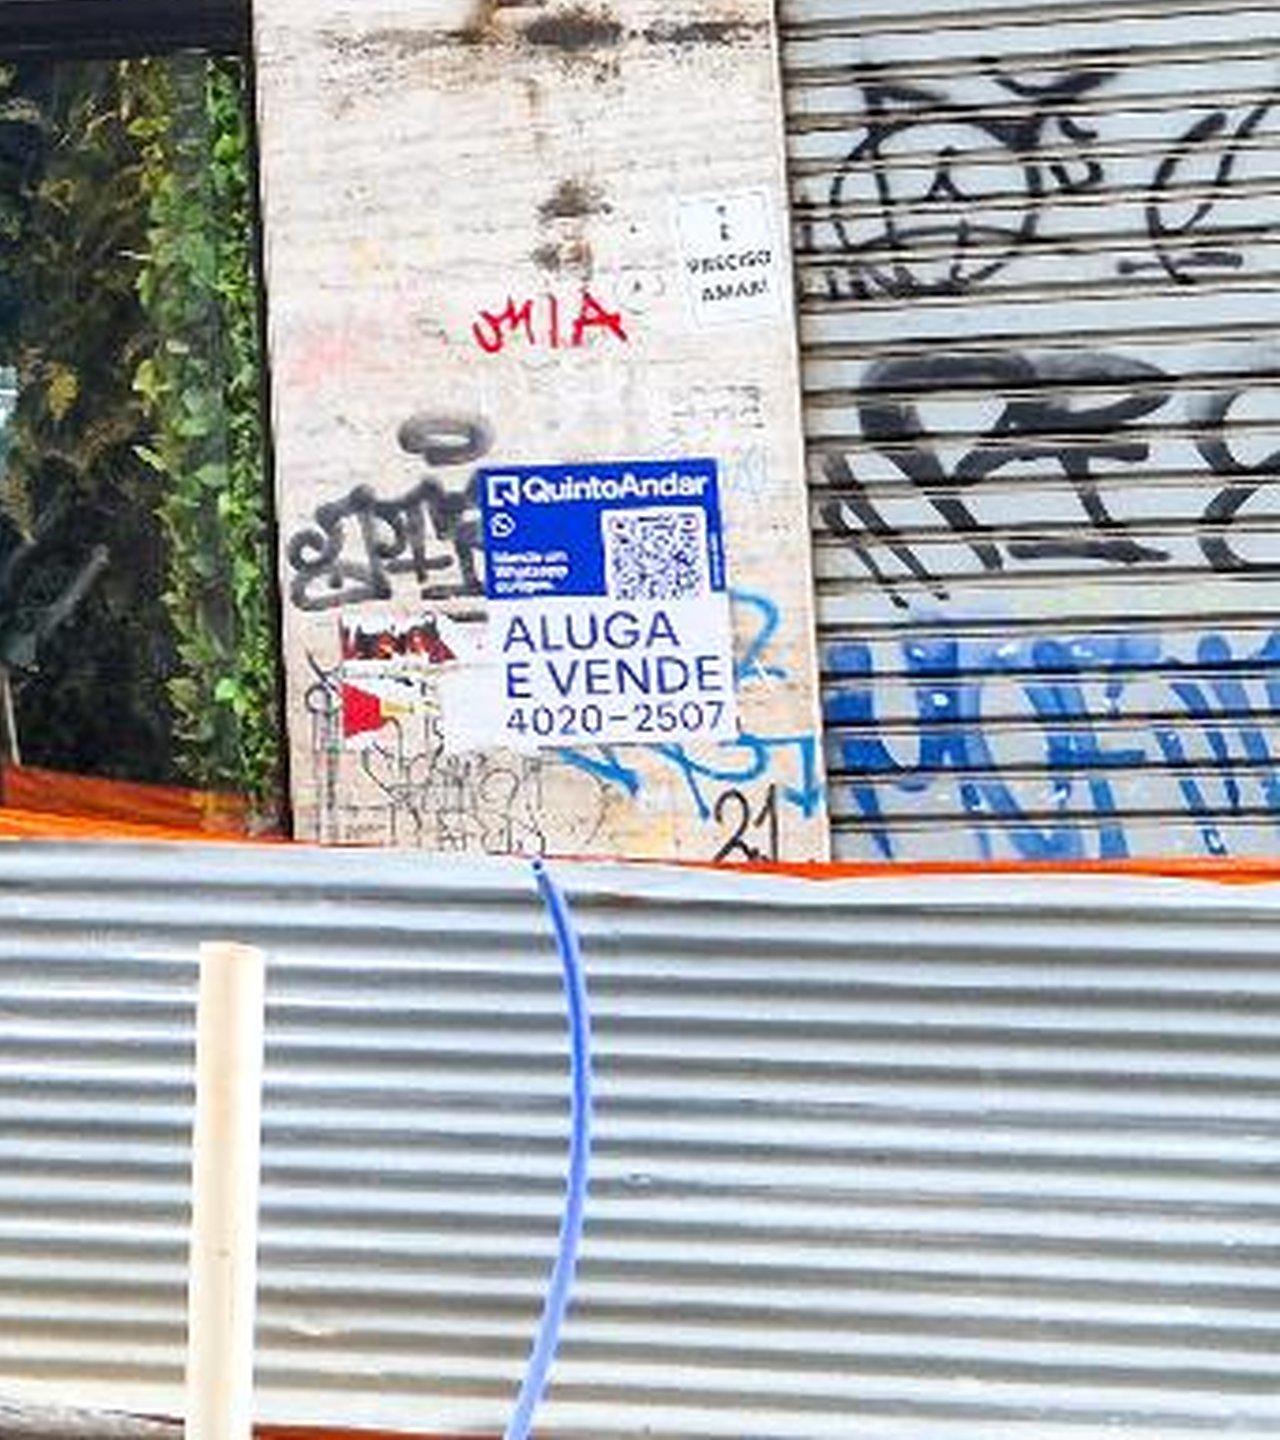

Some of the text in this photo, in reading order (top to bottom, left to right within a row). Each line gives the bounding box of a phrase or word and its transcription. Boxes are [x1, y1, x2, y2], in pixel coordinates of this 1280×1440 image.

[522, 471, 709, 503] QuintoAndar
[502, 610, 681, 653] ALUGA
[506, 655, 724, 698] E VENDE
[505, 700, 726, 736] 4020-2507
